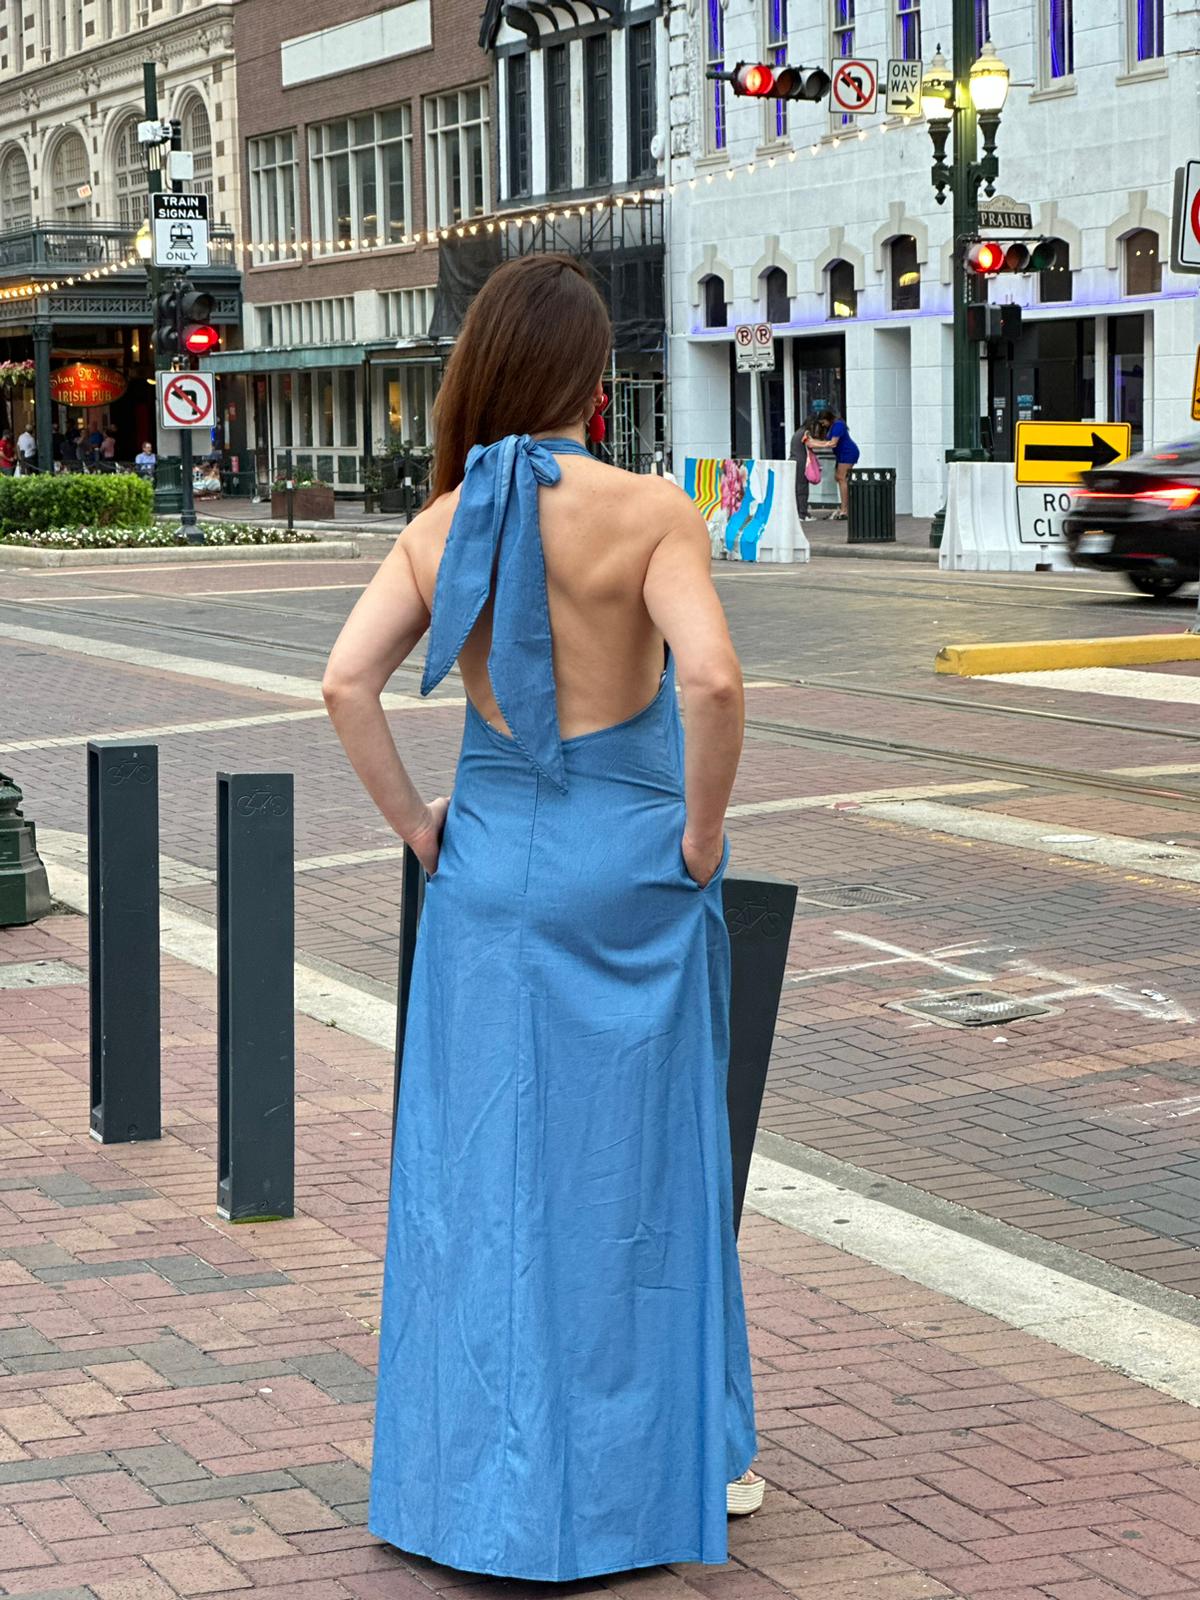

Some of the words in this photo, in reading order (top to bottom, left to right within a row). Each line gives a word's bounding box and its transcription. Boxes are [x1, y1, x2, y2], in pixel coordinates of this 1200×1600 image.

[892, 64, 918, 78] ONE
[891, 80, 918, 93] WAY
[162, 196, 199, 207] TRAIN
[158, 208, 203, 219] SIGNAL
[981, 212, 1030, 228] PRAIRIE
[166, 251, 198, 261] ONLY
[58, 390, 87, 402] IRISH
[92, 390, 112, 402] PUB
[1043, 493, 1071, 512] RO
